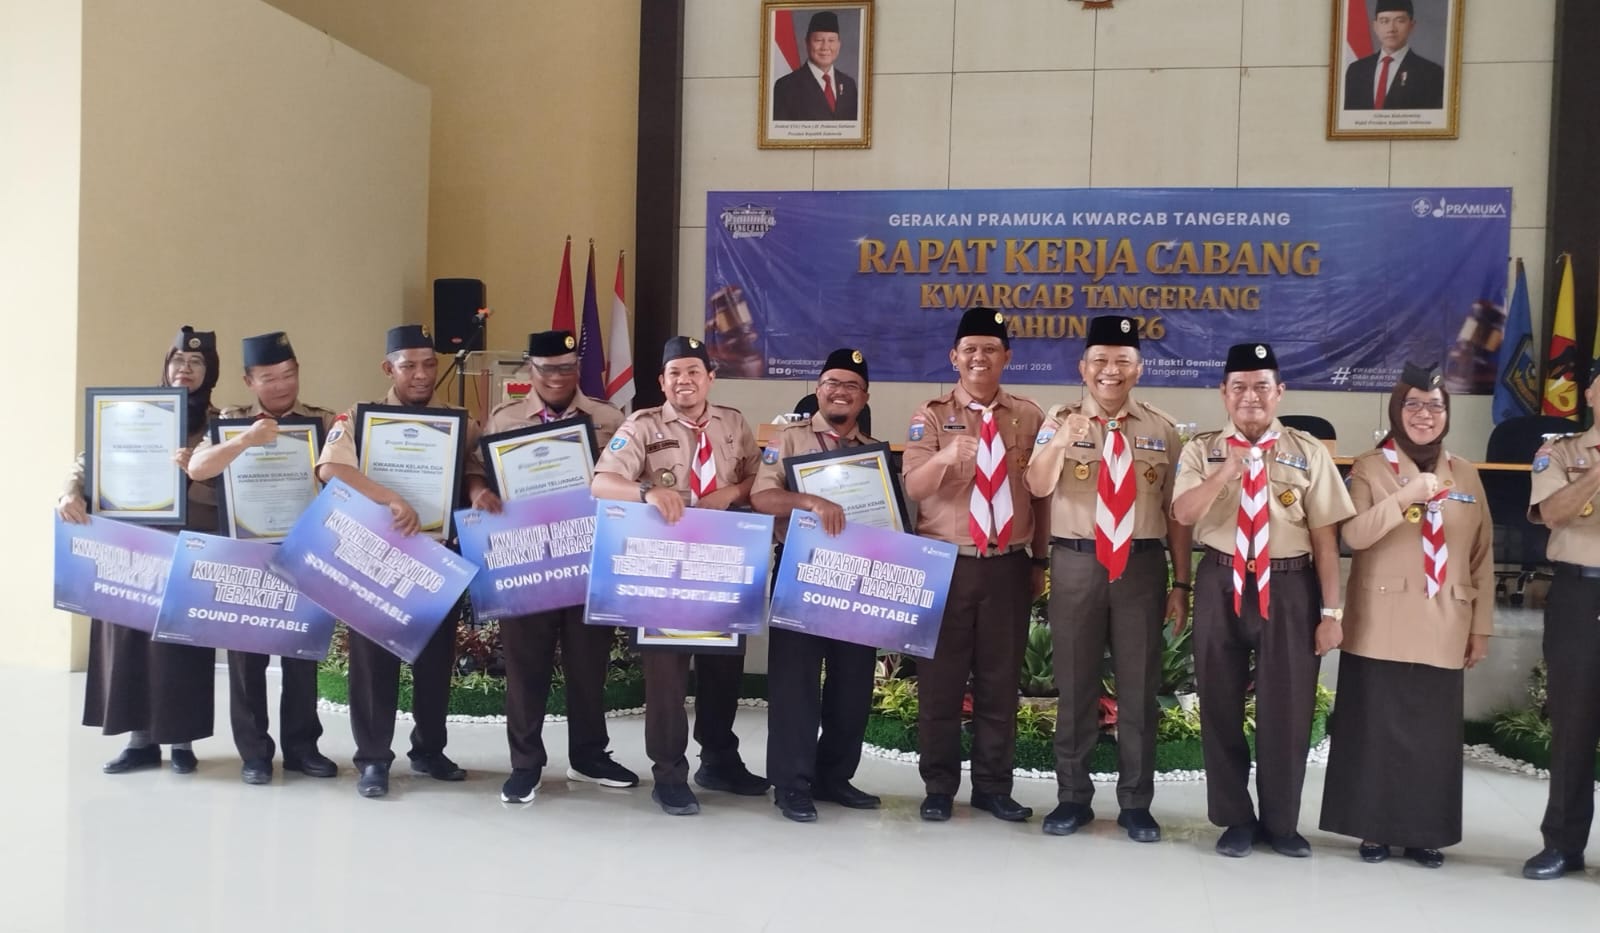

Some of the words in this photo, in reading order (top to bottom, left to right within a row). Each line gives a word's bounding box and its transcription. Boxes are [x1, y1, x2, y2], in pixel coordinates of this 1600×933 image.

[888, 213, 972, 227] GERAKAN
[978, 212, 1067, 227] PRAMUKA
[1072, 212, 1168, 227] KWARCAB
[1173, 211, 1291, 226] TANGERANG
[1446, 203, 1506, 214] PRAMUKA
[857, 238, 998, 275] RAPAT
[1004, 237, 1139, 282] KERJA
[1146, 240, 1322, 276] CABANG
[919, 282, 1075, 310] KWARCAB
[1081, 284, 1261, 311] TANGERANG
[1133, 316, 1166, 340] 26
[1148, 368, 1199, 378] Tangerang
[1158, 358, 1184, 366] Bakti
[1186, 359, 1226, 367] Gemilan
[490, 524, 550, 551] KWARTIR
[549, 516, 597, 540] RANTIN
[324, 509, 389, 559] KWARTIR
[384, 544, 445, 594] RANTING
[335, 539, 402, 588] TERAKTIF
[484, 543, 546, 570] TERAKTIF
[549, 535, 594, 559] HARAP
[192, 560, 260, 588] KWARTIR
[496, 572, 543, 591] SOUND
[545, 564, 592, 582] PORTA
[812, 547, 871, 576] KWARTIR
[870, 559, 926, 588] RANTING
[215, 583, 284, 609] TERAKTIF
[304, 552, 351, 588] SOUND
[347, 578, 412, 626] PORTABLE
[616, 584, 668, 599] SOUND
[670, 588, 741, 603] PORTABLE
[797, 562, 857, 591] TERAKTIF
[859, 577, 920, 606] HARAPAN
[919, 590, 935, 609] III
[188, 607, 238, 624] SOUND
[240, 614, 309, 633] PORTABLE
[803, 591, 850, 610] SOUND
[852, 601, 919, 625] PORTABLE
